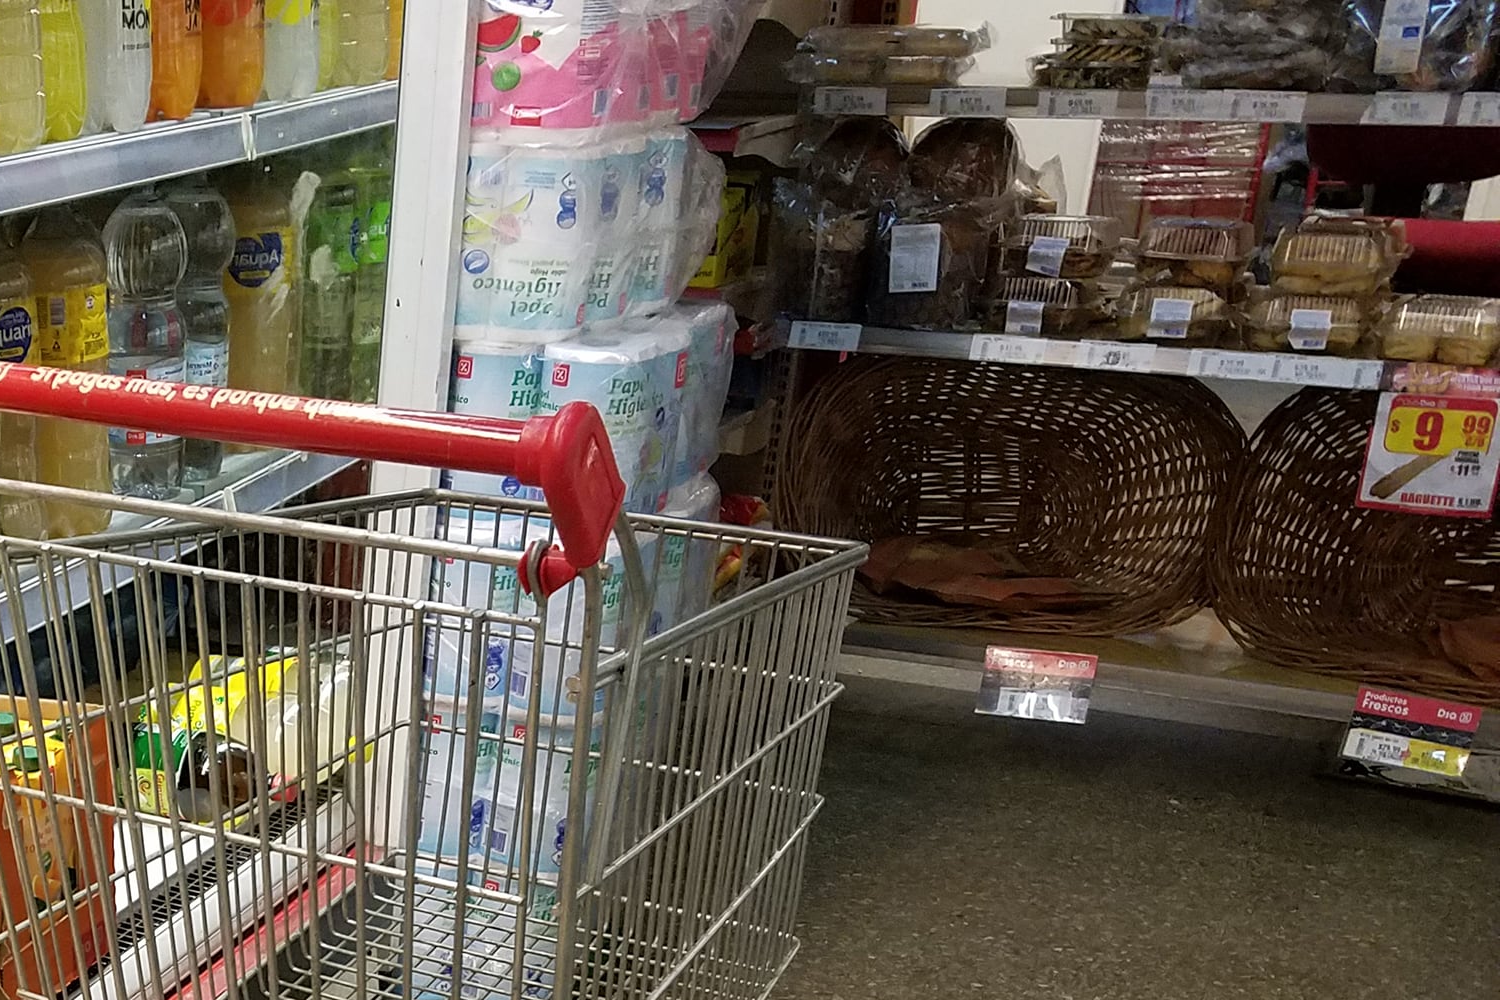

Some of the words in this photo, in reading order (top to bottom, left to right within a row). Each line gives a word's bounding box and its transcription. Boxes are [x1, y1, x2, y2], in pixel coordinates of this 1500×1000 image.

[49, 370, 126, 394] pagas
[182, 386, 213, 401] es
[210, 388, 301, 415] porque
[1413, 411, 1445, 451] 9
[1463, 414, 1492, 435] 99
[1401, 492, 1456, 507] BAGUETTE
[1364, 691, 1408, 706] Productos
[1437, 708, 1458, 721] Dia
